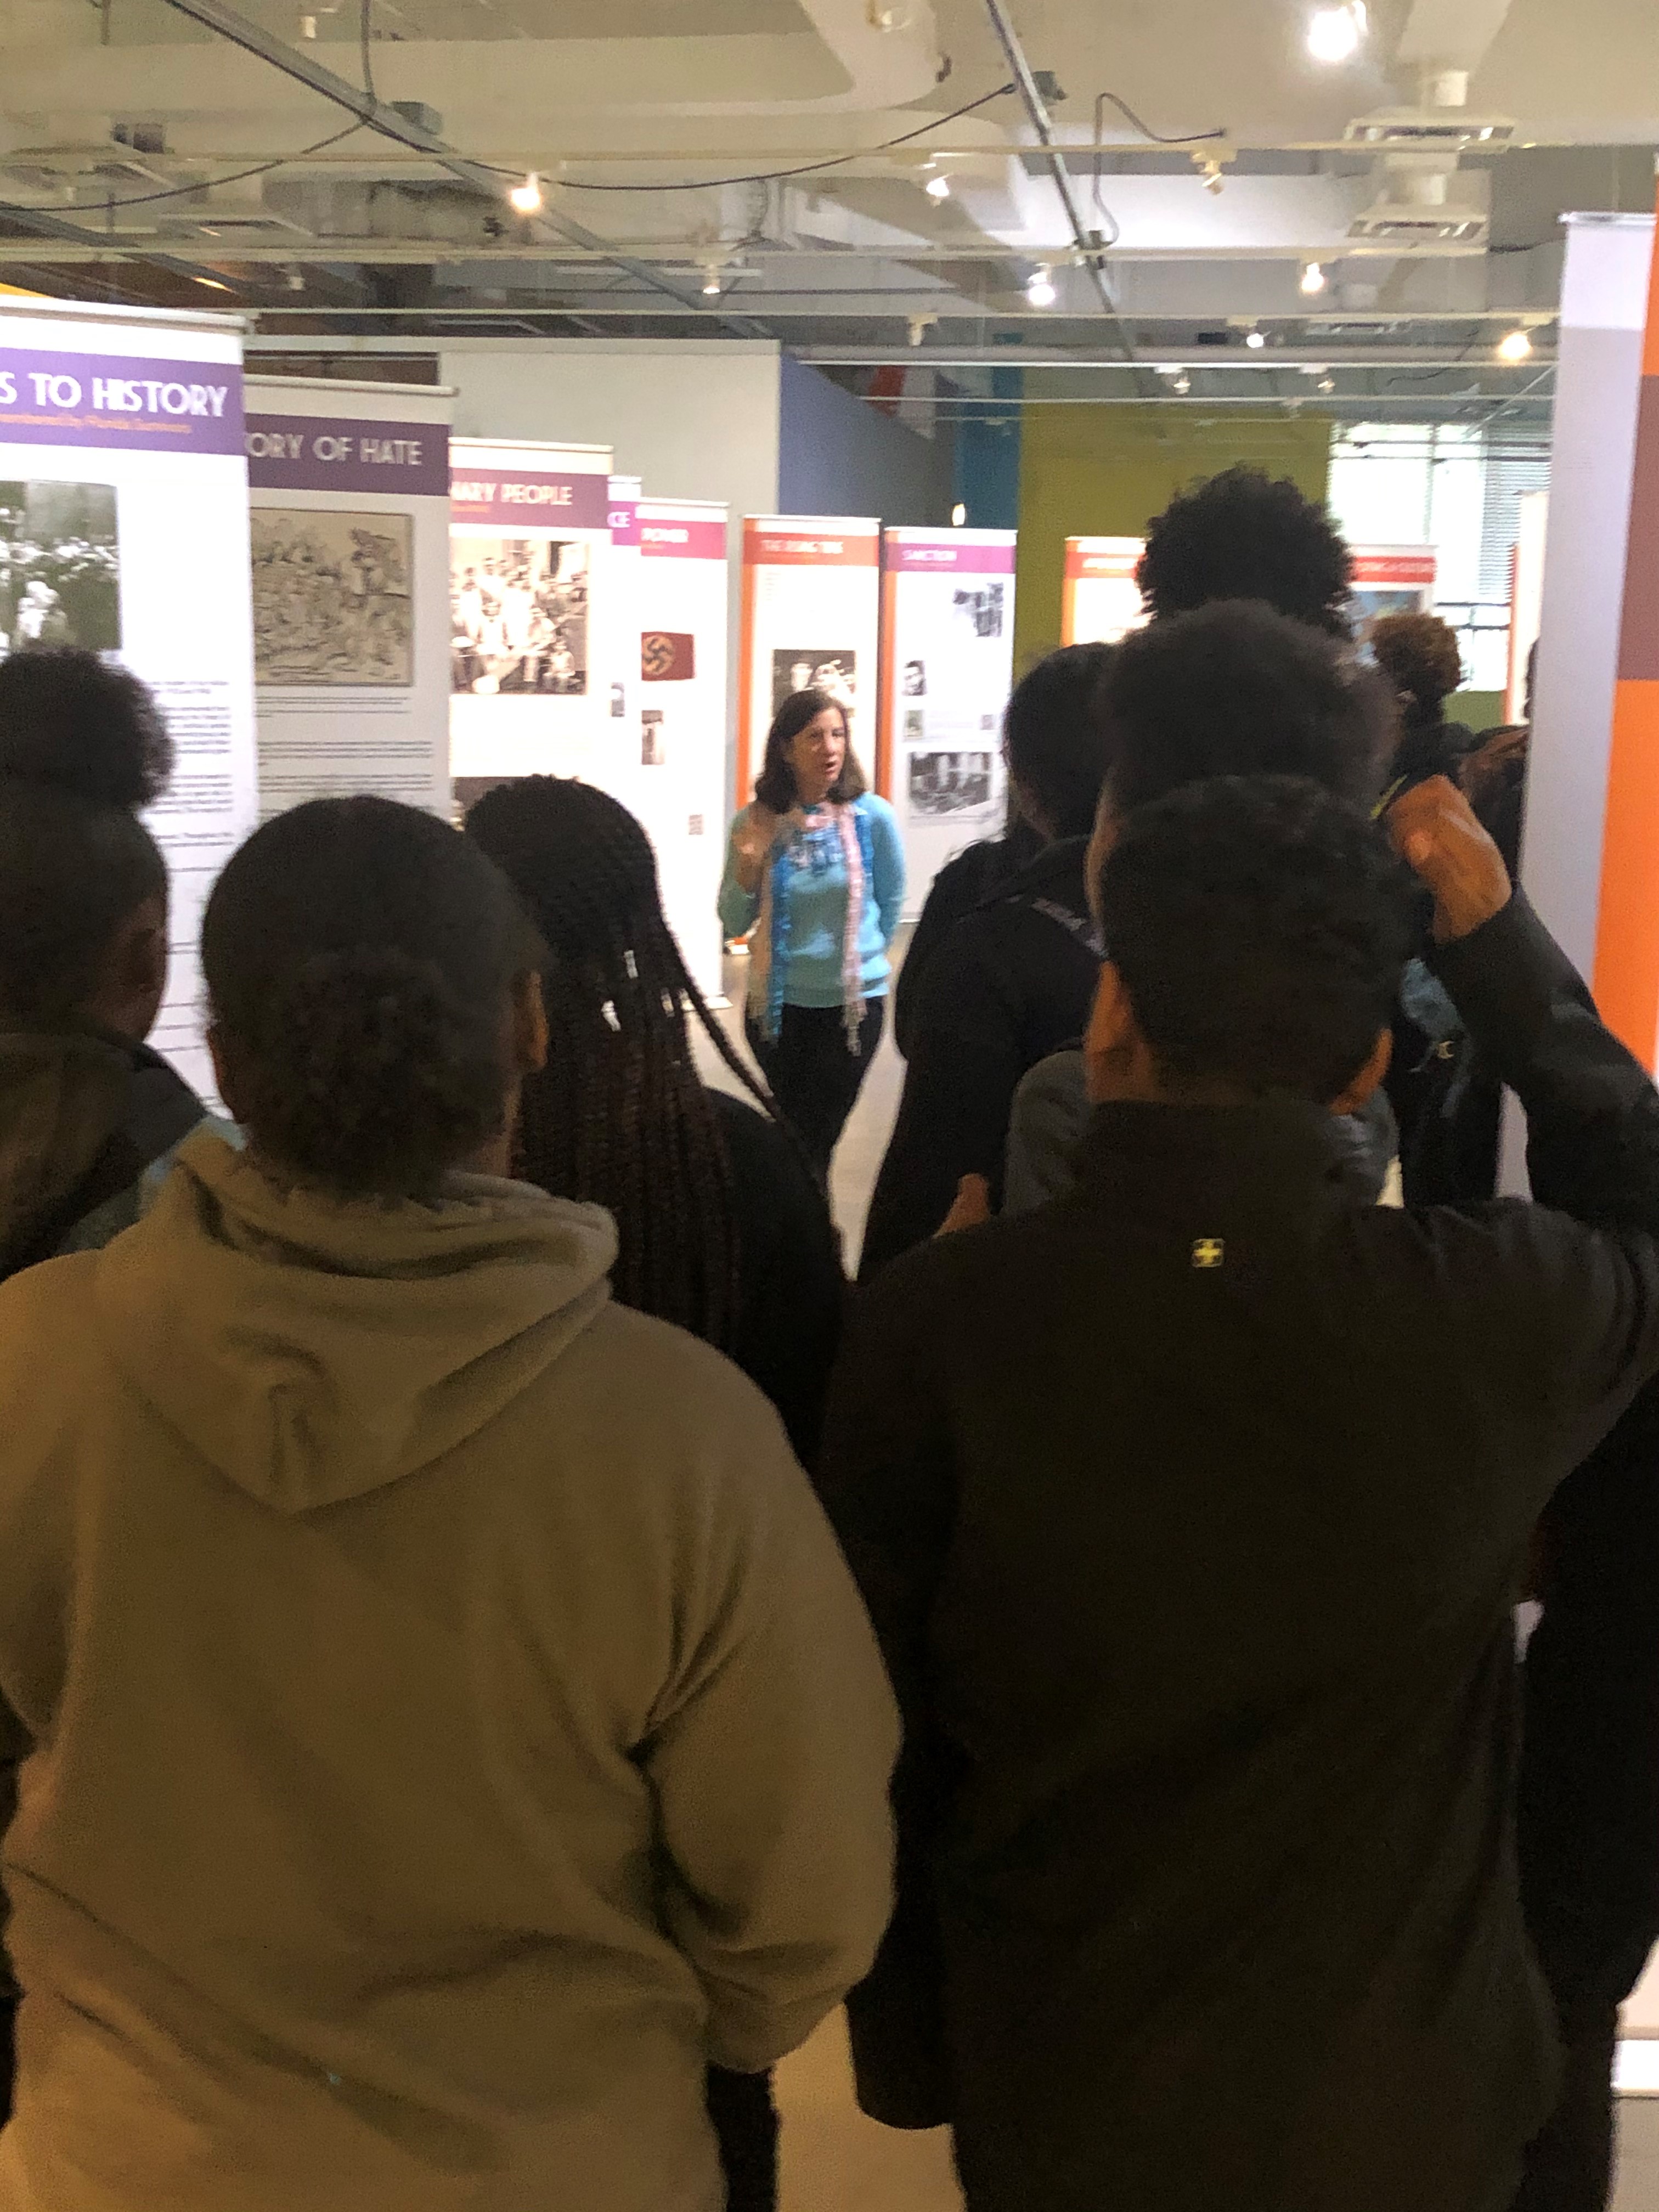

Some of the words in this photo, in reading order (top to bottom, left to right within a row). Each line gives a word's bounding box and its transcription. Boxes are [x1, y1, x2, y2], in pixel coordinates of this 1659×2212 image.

[28, 373, 82, 408] TO
[92, 377, 229, 417] HISTORY
[312, 436, 352, 461] OF
[359, 438, 422, 465] HATE
[501, 483, 573, 505] PEOPLE
